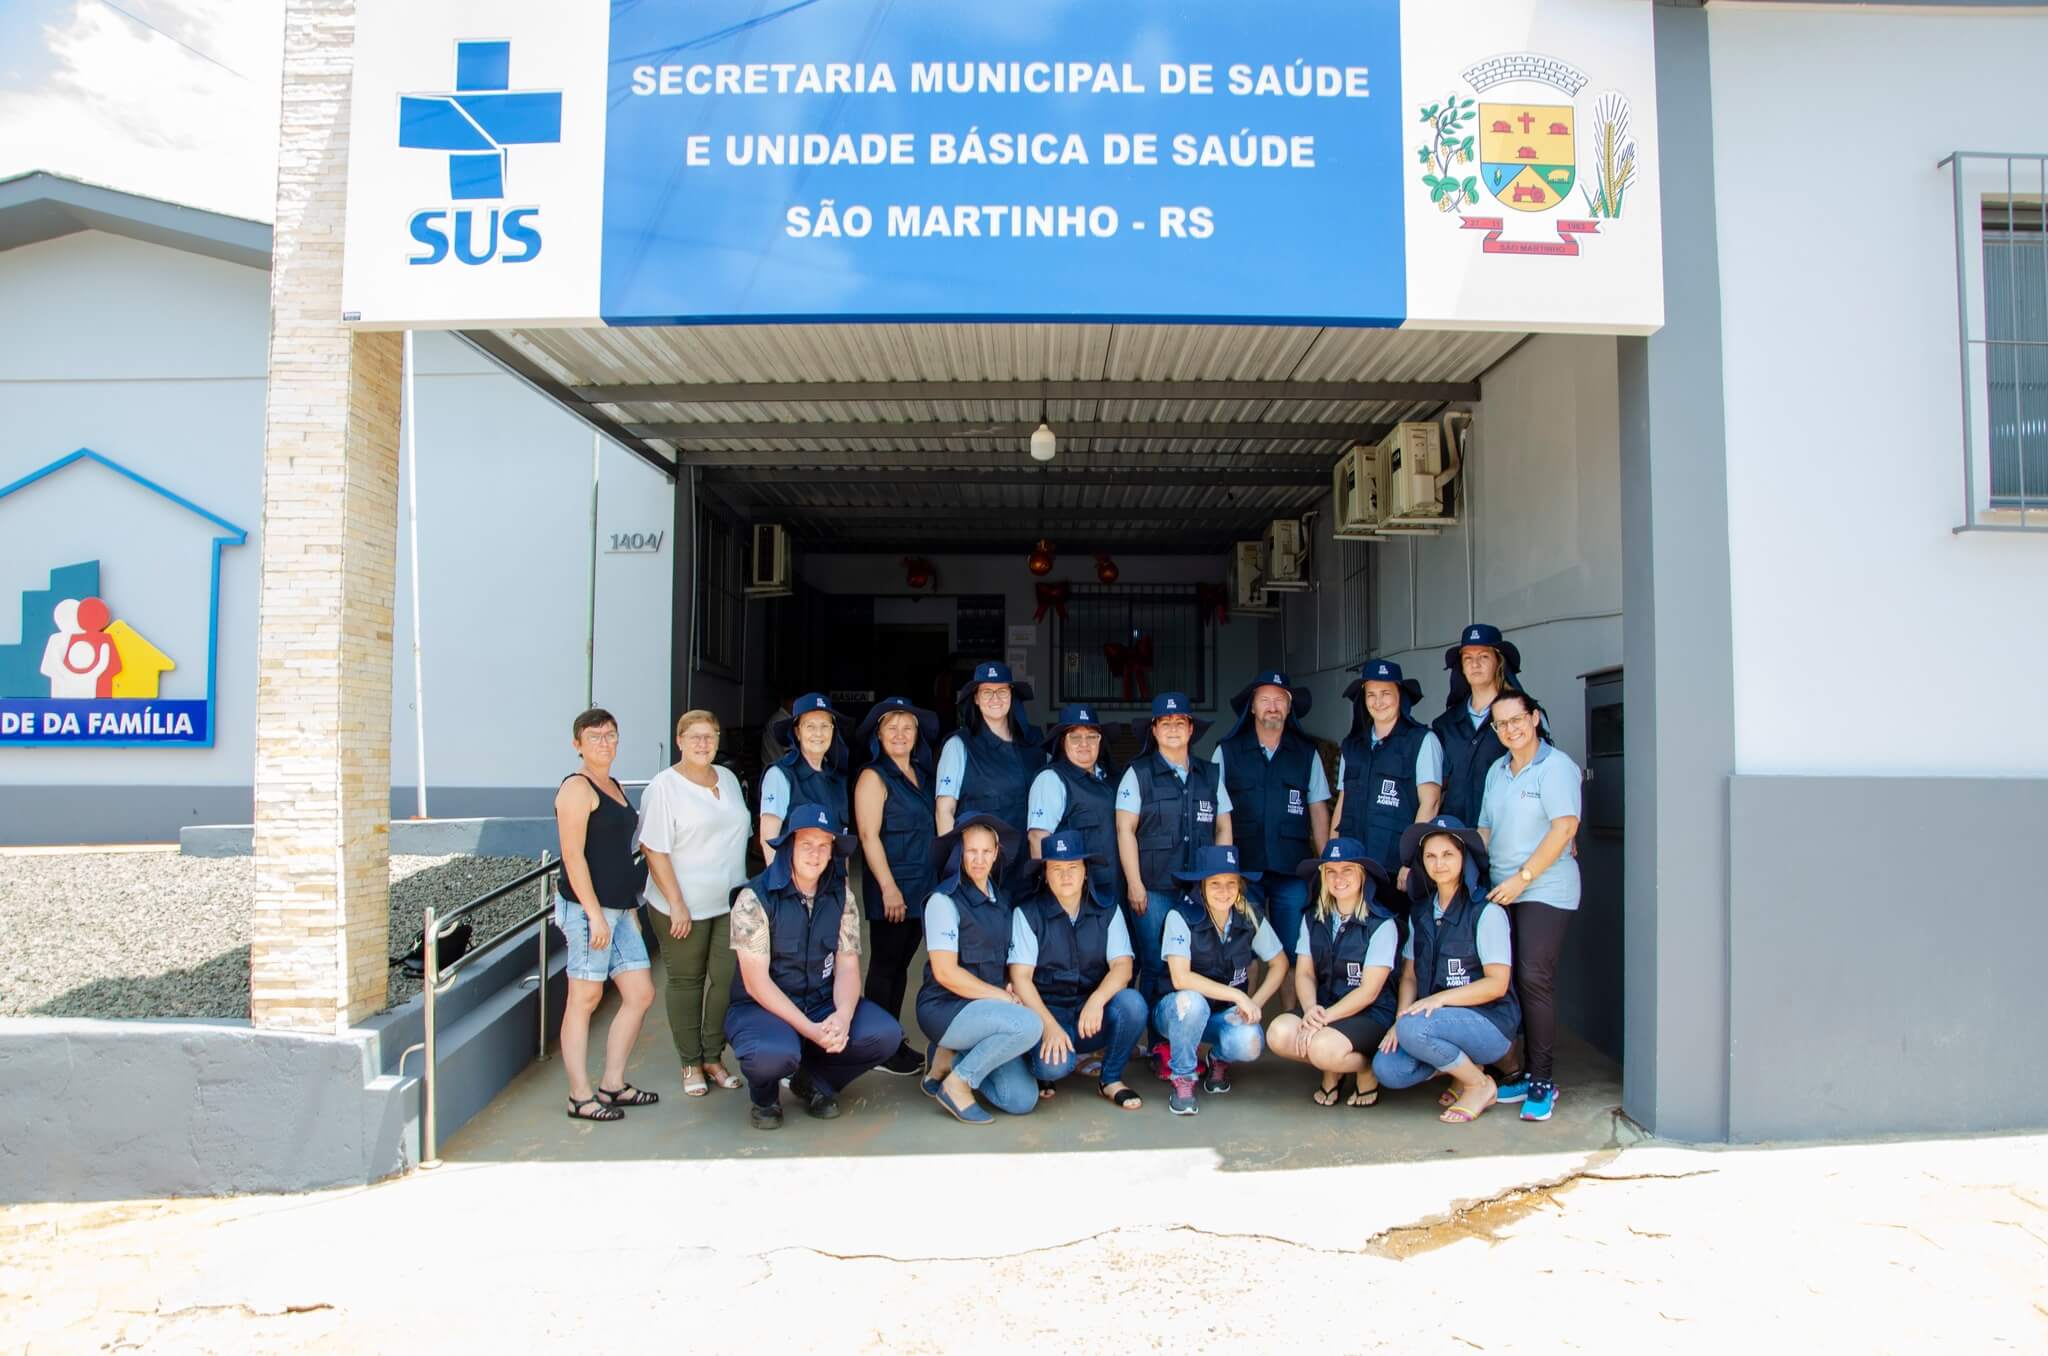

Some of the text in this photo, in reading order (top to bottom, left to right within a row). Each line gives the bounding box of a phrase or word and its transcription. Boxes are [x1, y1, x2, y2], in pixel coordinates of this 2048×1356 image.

[631, 59, 1370, 97] SECRETARIA MUNICIPAL DE SAÚDE
[686, 127, 1315, 168] E UNIDADE BÁSICA DE SAÚDE
[408, 207, 542, 266] SUS
[785, 200, 1215, 239] SÃO MARTINHO - RS
[610, 532, 657, 550] 1404
[43, 712, 81, 734] DA
[88, 706, 194, 735] FAMÍLIA
